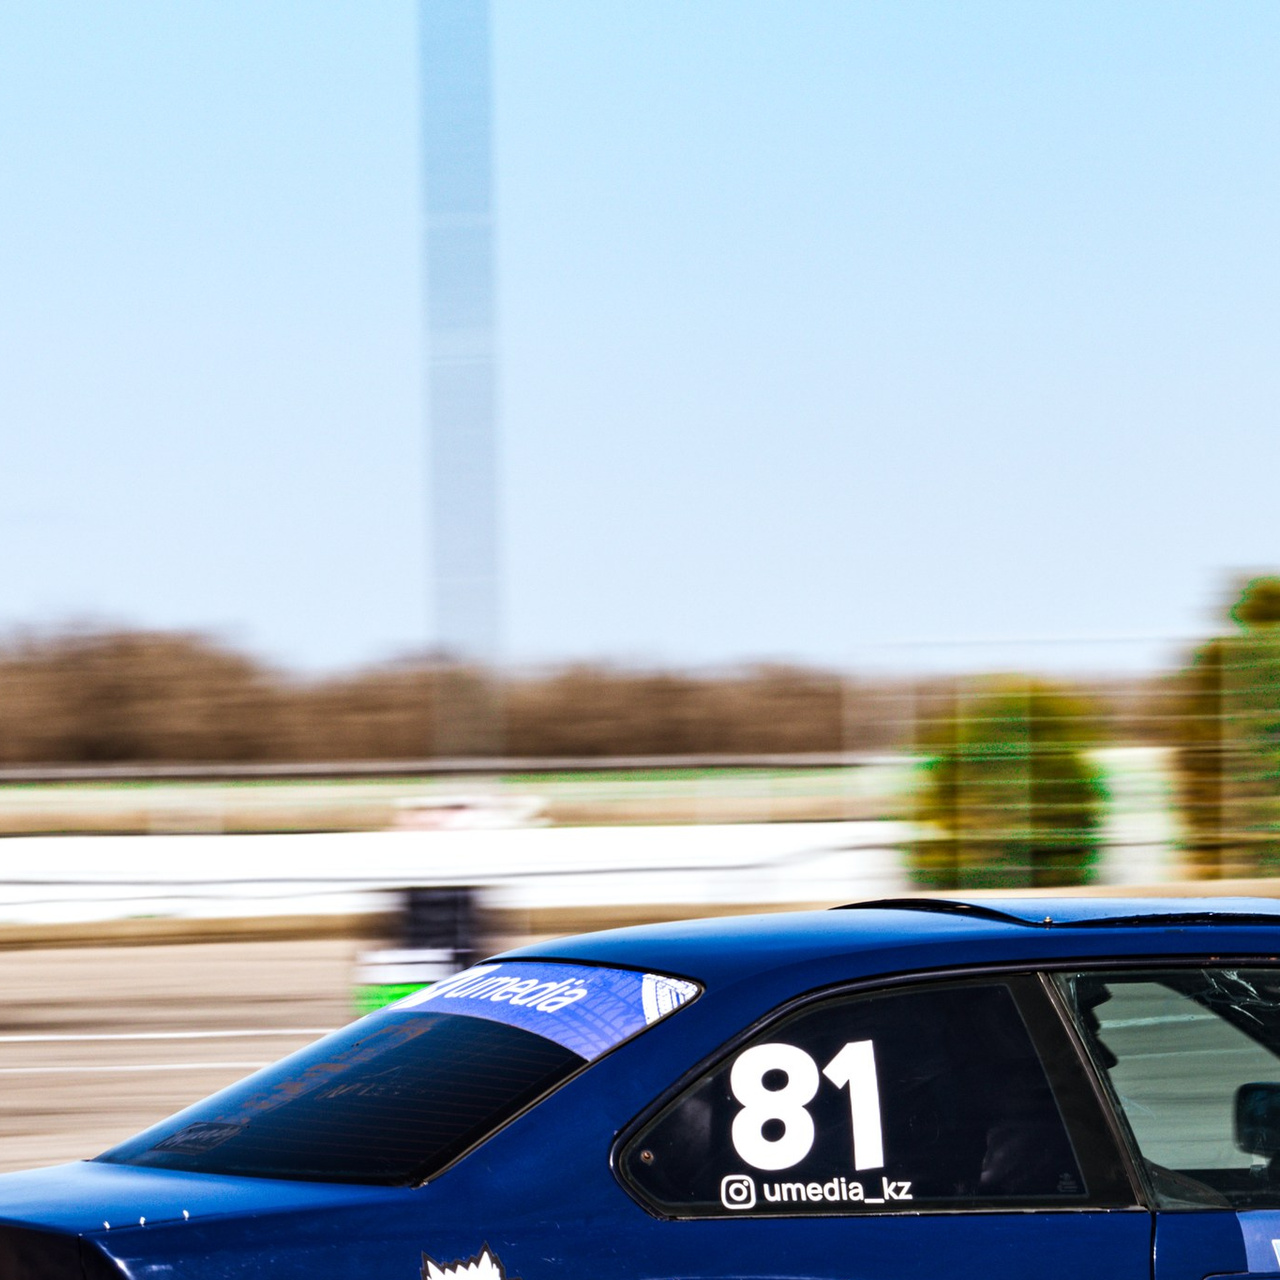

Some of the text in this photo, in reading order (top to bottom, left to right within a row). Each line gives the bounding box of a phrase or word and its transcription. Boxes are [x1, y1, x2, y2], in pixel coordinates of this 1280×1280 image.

[444, 976, 588, 1013] umedia
[730, 1039, 884, 1171] 81
[763, 1177, 913, 1204] umedia_kz
